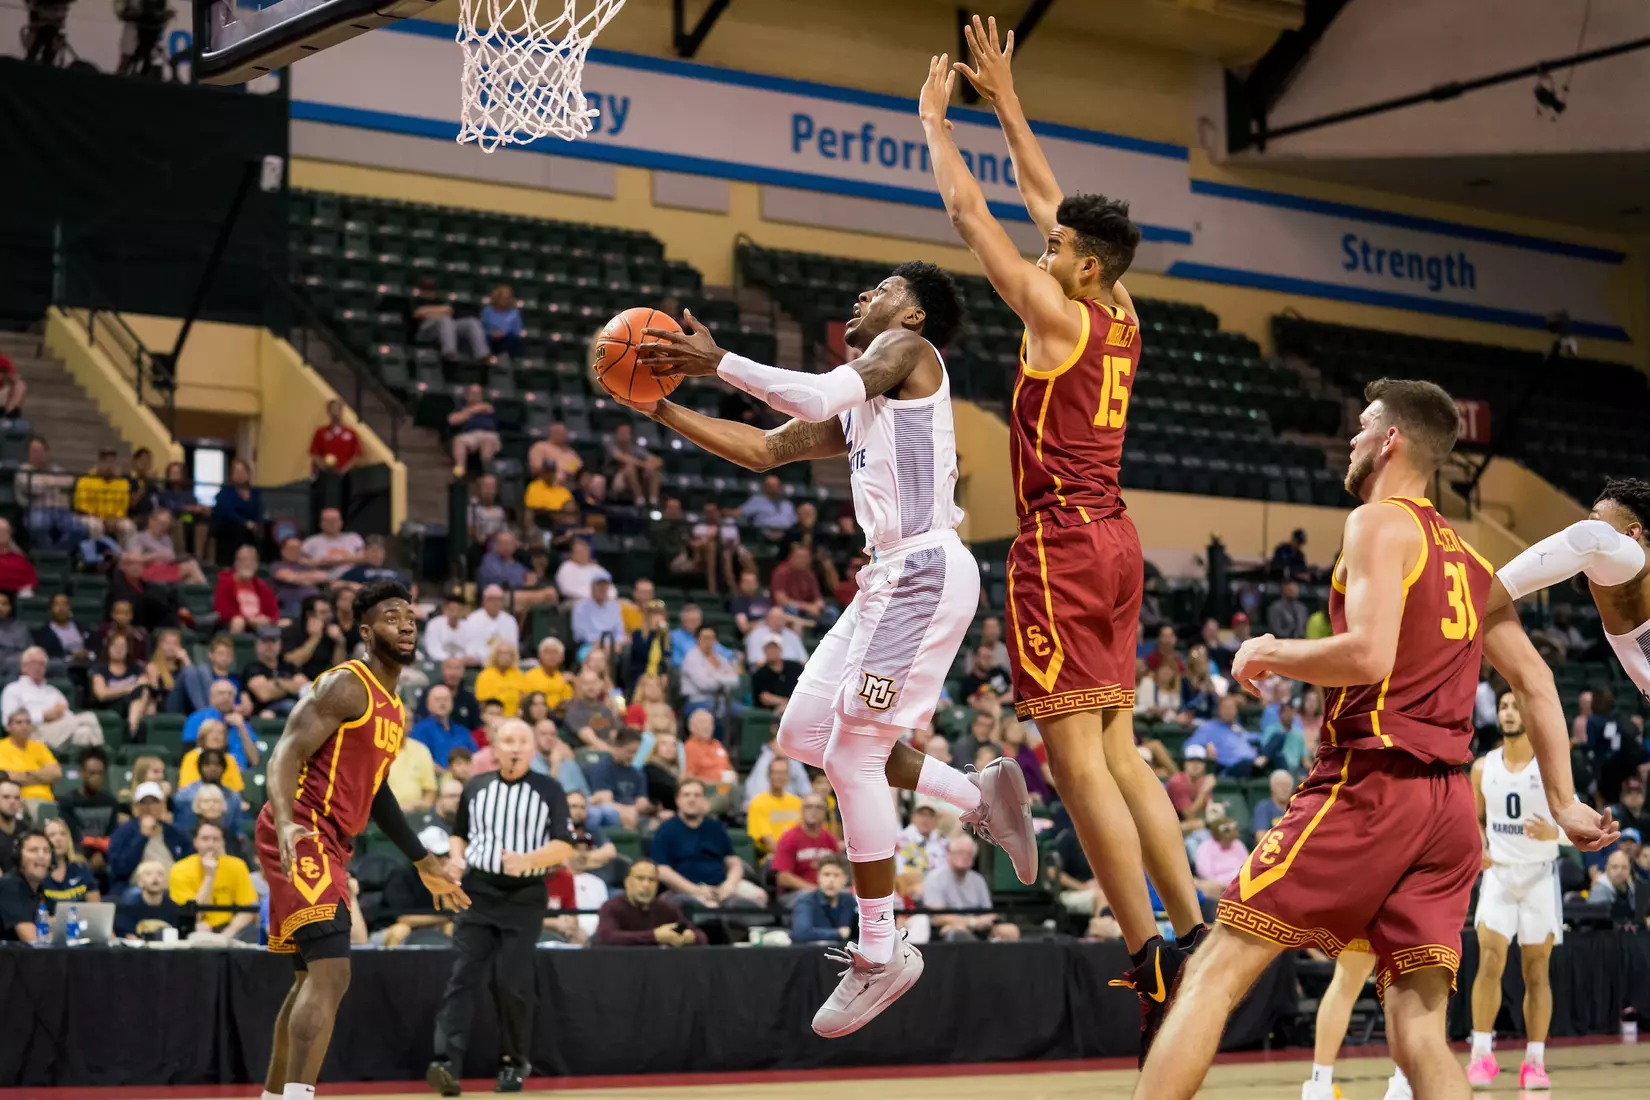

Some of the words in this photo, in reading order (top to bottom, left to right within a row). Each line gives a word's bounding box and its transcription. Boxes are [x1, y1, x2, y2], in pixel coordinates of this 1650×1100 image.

[1341, 233, 1477, 292] Strength
[1093, 354, 1131, 428] 15
[1441, 561, 1478, 640] 31
[858, 672, 898, 712] MU
[1506, 792, 1521, 819] 0
